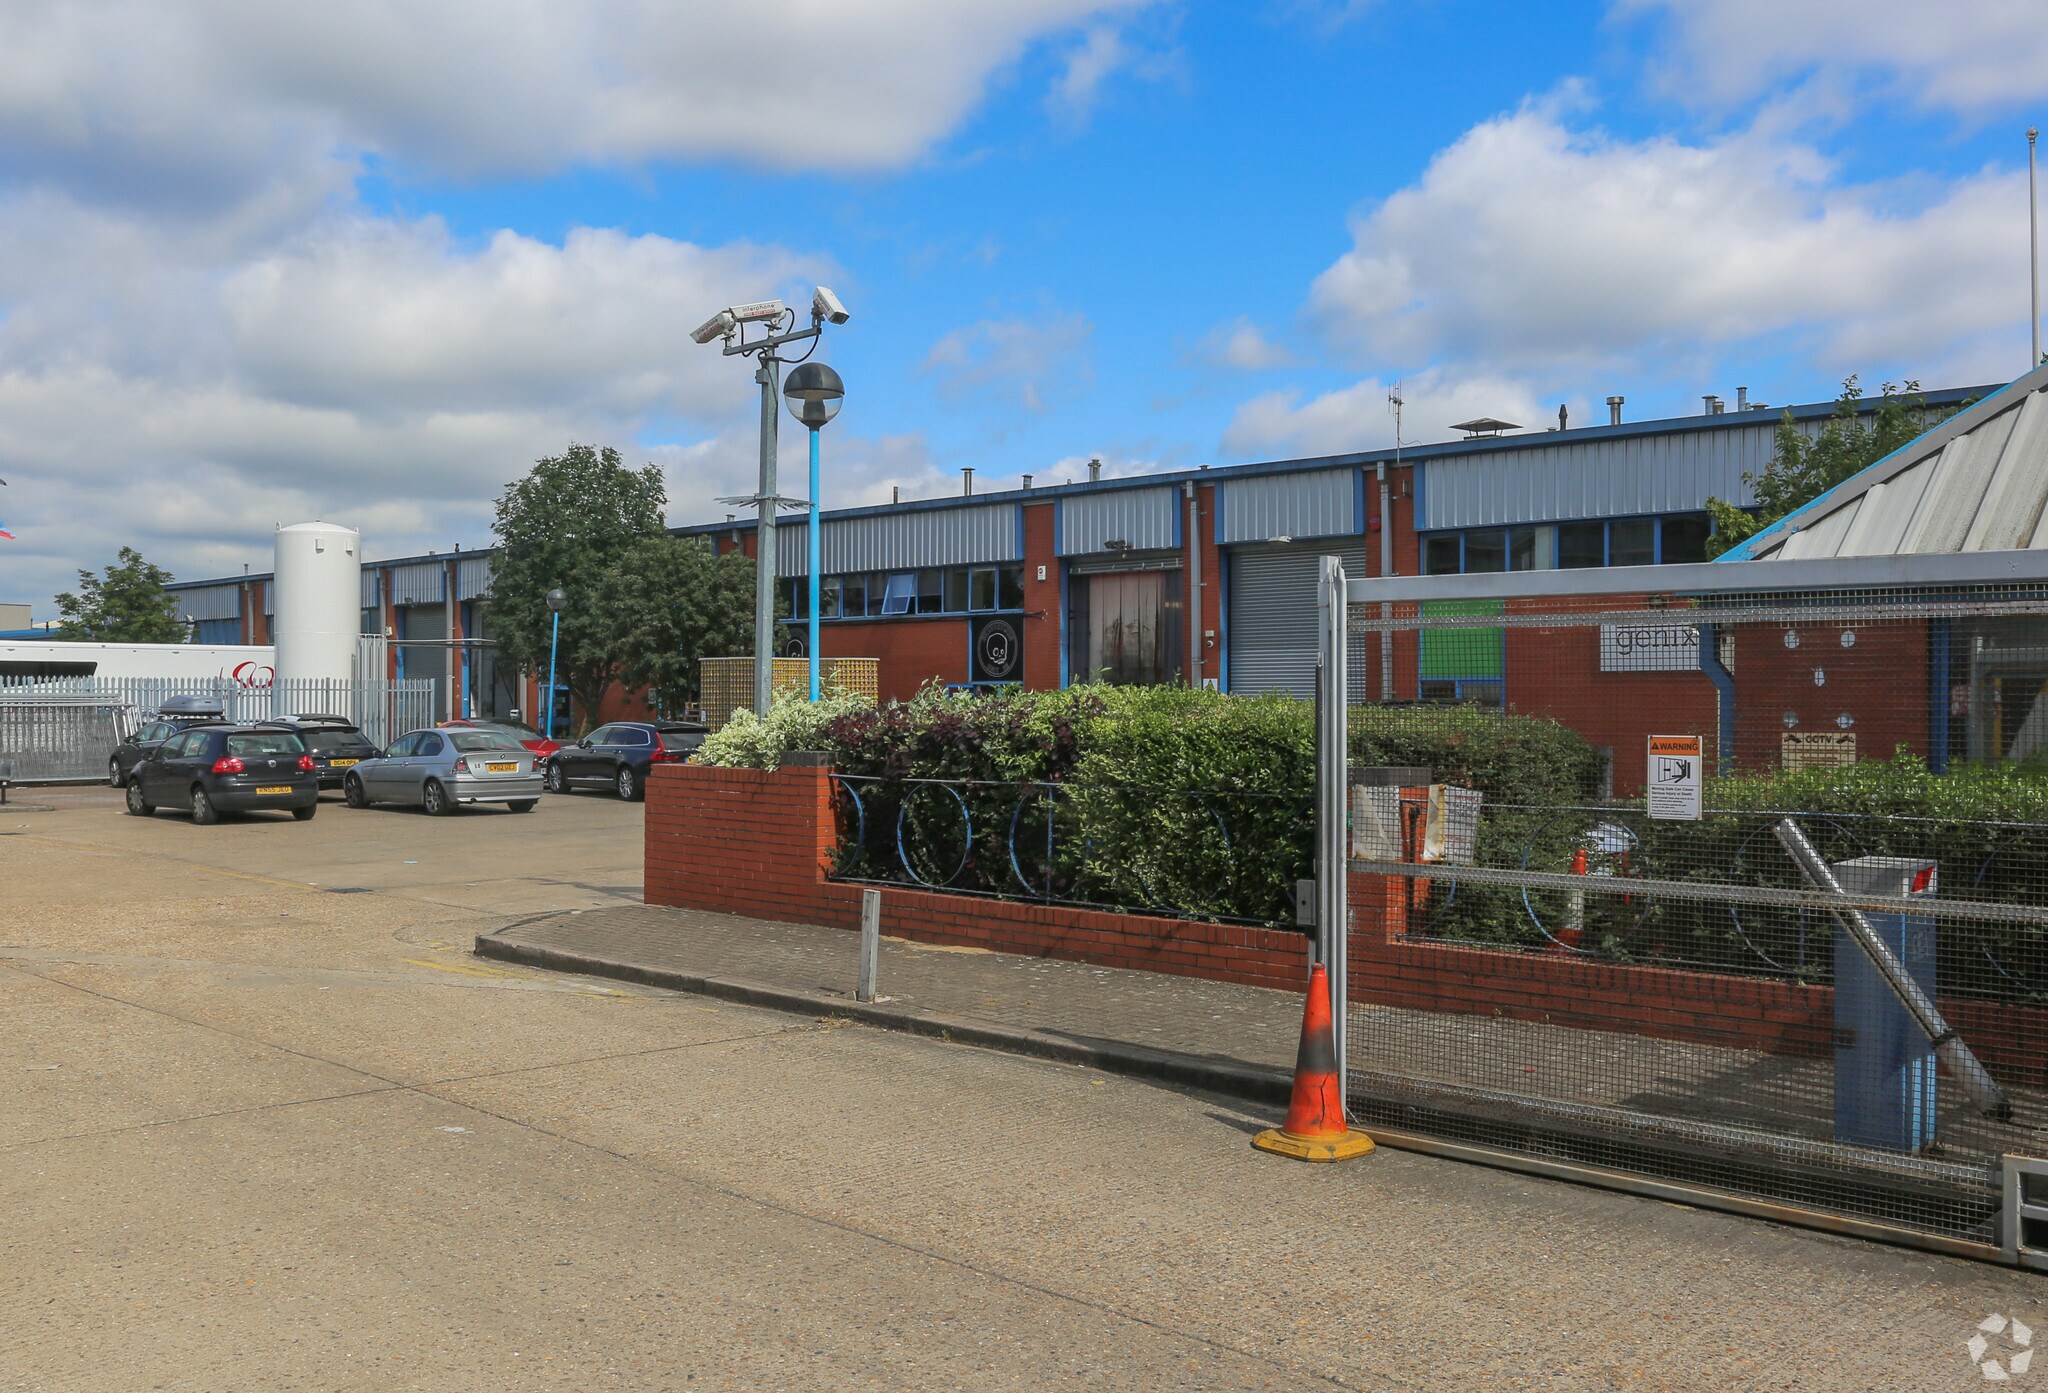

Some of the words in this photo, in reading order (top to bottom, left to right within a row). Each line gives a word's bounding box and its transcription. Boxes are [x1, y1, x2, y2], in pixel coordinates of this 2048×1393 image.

[742, 303, 775, 313] interphone
[1616, 629, 1698, 656] genix
[1805, 735, 1833, 744] CCTV
[1659, 742, 1699, 751] WARNING
